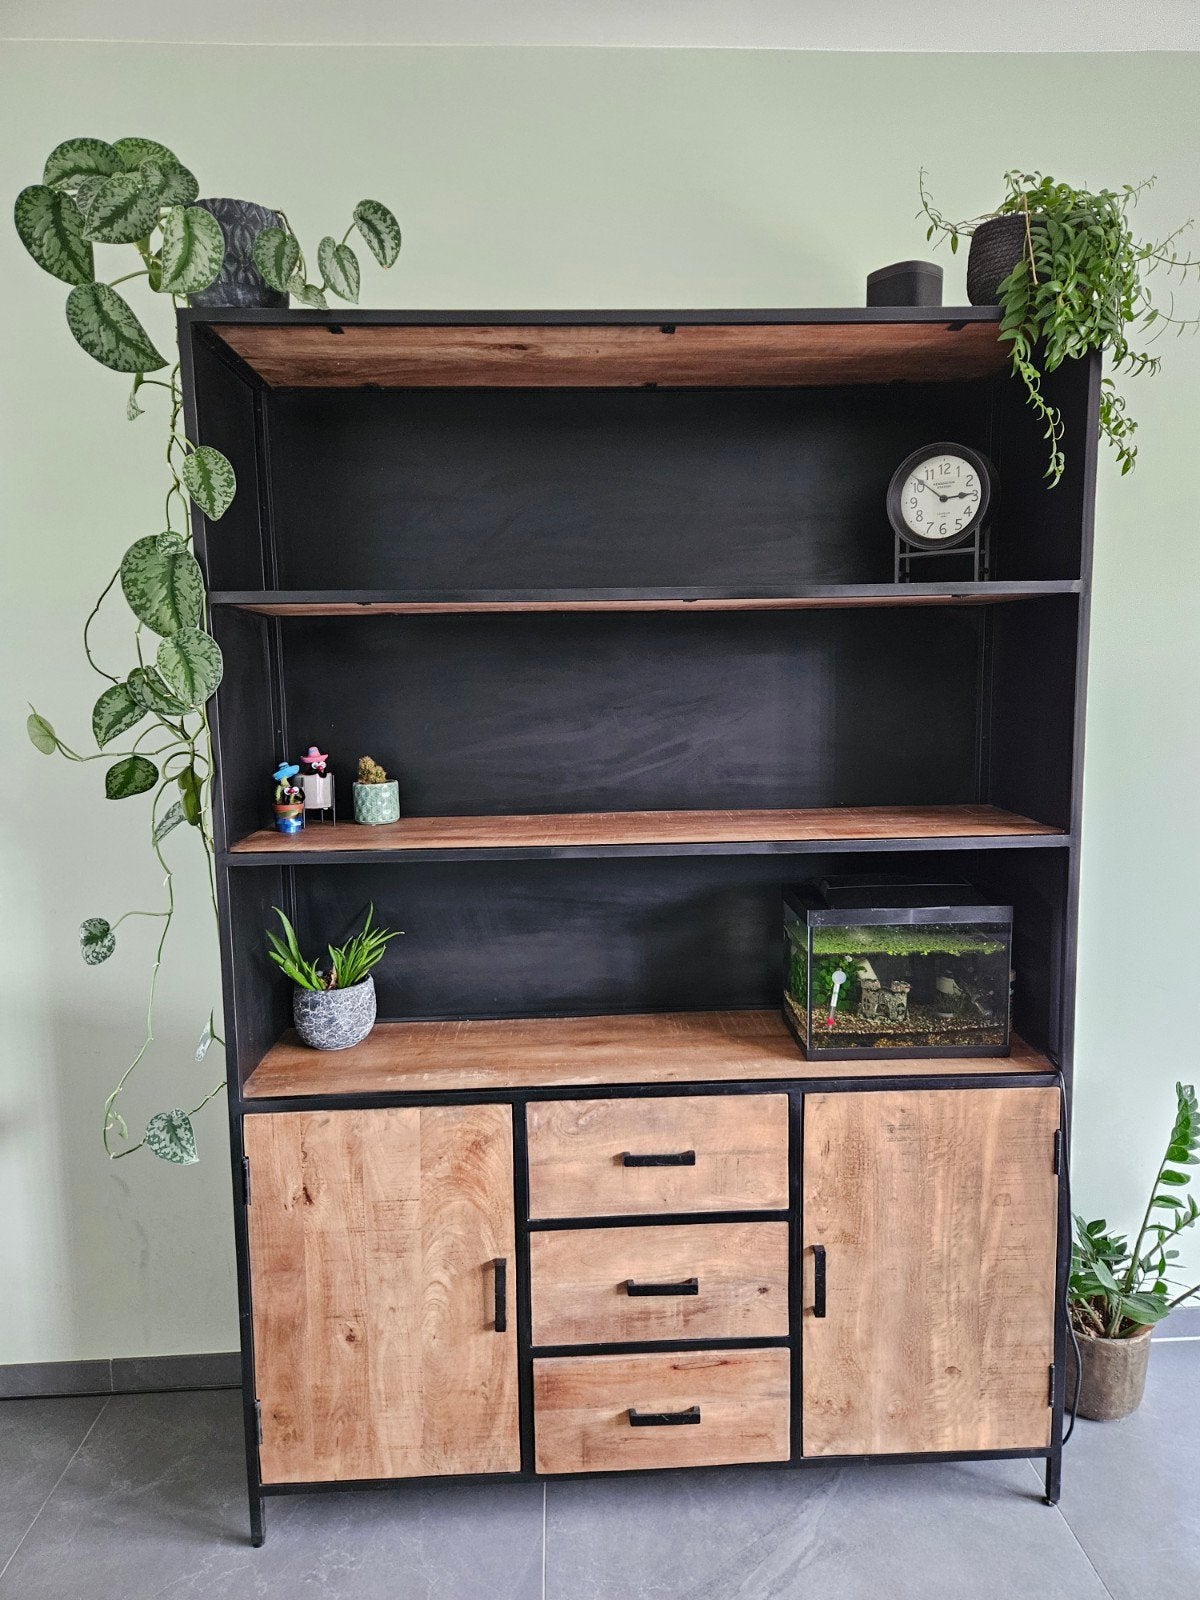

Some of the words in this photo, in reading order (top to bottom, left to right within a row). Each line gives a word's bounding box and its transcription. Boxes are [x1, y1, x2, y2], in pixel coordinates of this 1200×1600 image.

[925, 469, 934, 480] 11
[938, 463, 951, 475] 12
[956, 465, 960, 477] 1
[965, 474, 974, 487] 2
[913, 481, 925, 493] 10
[971, 489, 979, 502] 3
[910, 497, 918, 509] 9
[916, 510, 923, 522] 8
[963, 505, 972, 517] 4
[926, 522, 934, 534] 7
[939, 523, 947, 535] 6
[955, 518, 963, 531] 5
